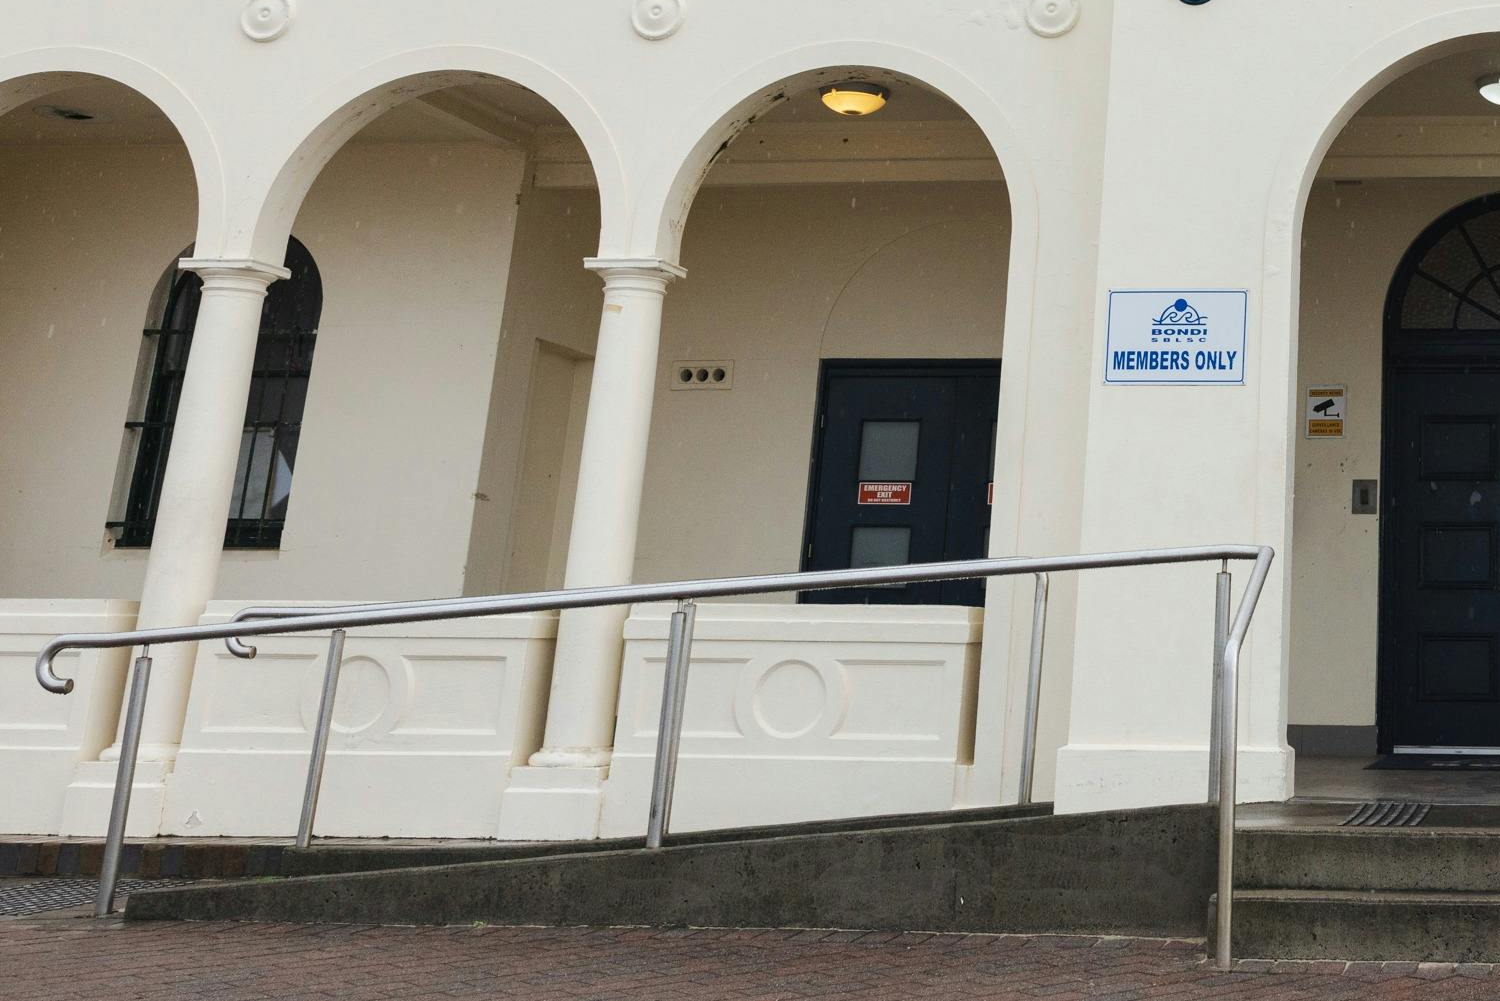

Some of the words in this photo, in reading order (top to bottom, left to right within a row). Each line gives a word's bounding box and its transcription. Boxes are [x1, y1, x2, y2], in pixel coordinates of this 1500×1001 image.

[1151, 328, 1207, 336] BONDI
[1113, 350, 1189, 370] MEMBERS
[1195, 350, 1237, 370] ONLY
